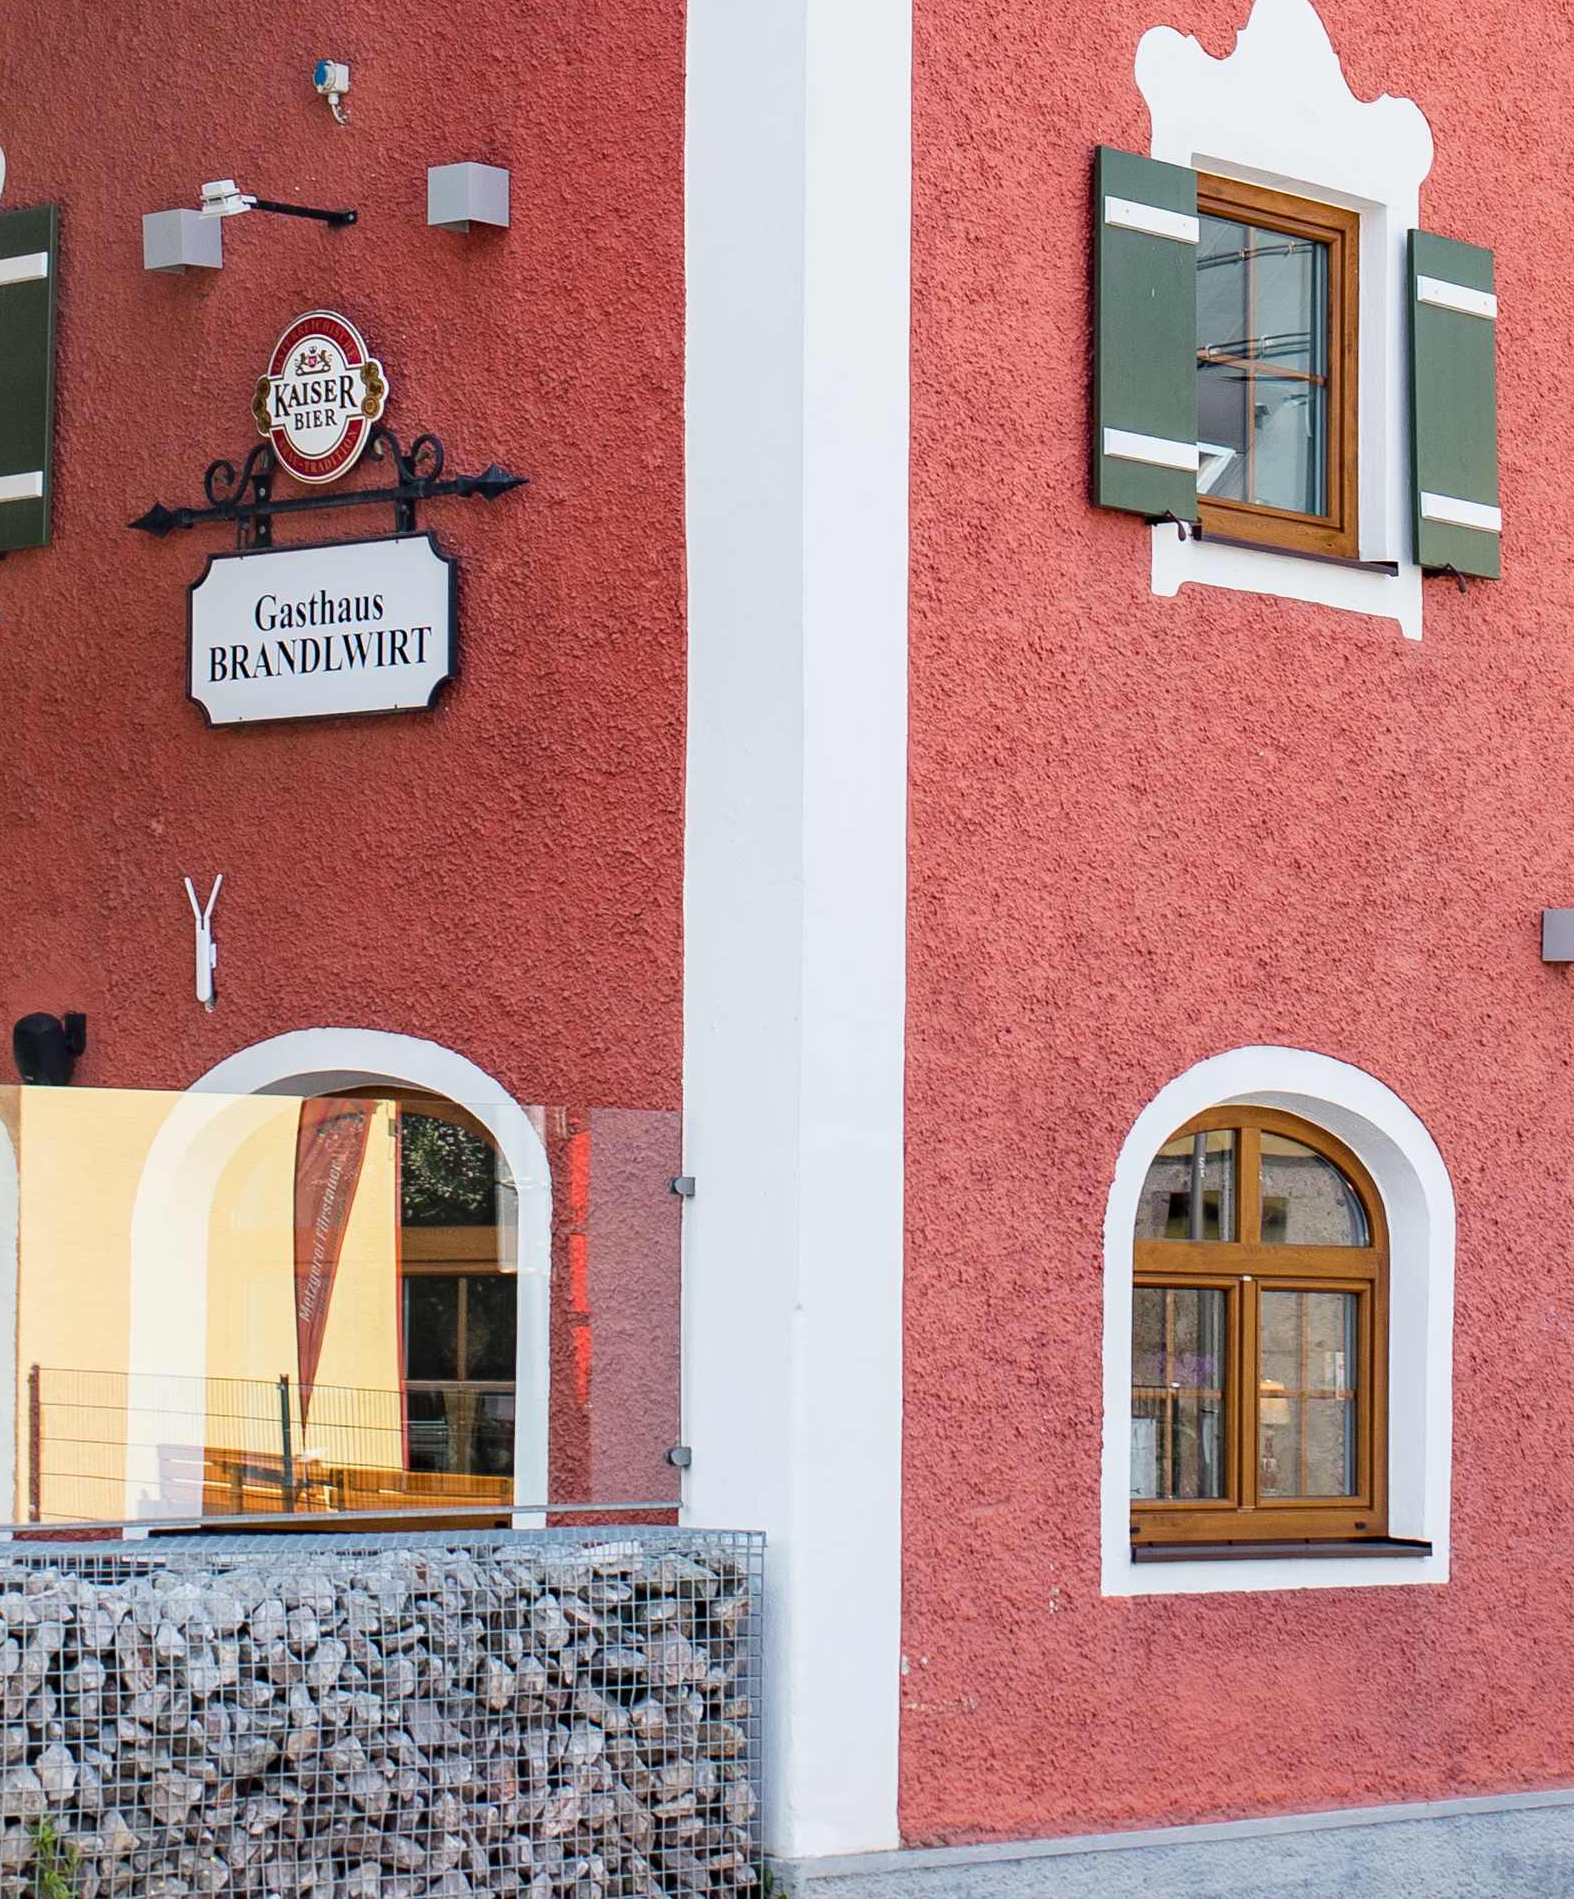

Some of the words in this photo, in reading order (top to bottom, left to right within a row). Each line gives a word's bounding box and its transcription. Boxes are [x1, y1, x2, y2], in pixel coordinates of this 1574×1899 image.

[274, 374, 358, 418] KAISER
[294, 408, 337, 431] BIER
[254, 589, 384, 632] Gasthaus
[208, 626, 432, 683] BRANDLWIRT
